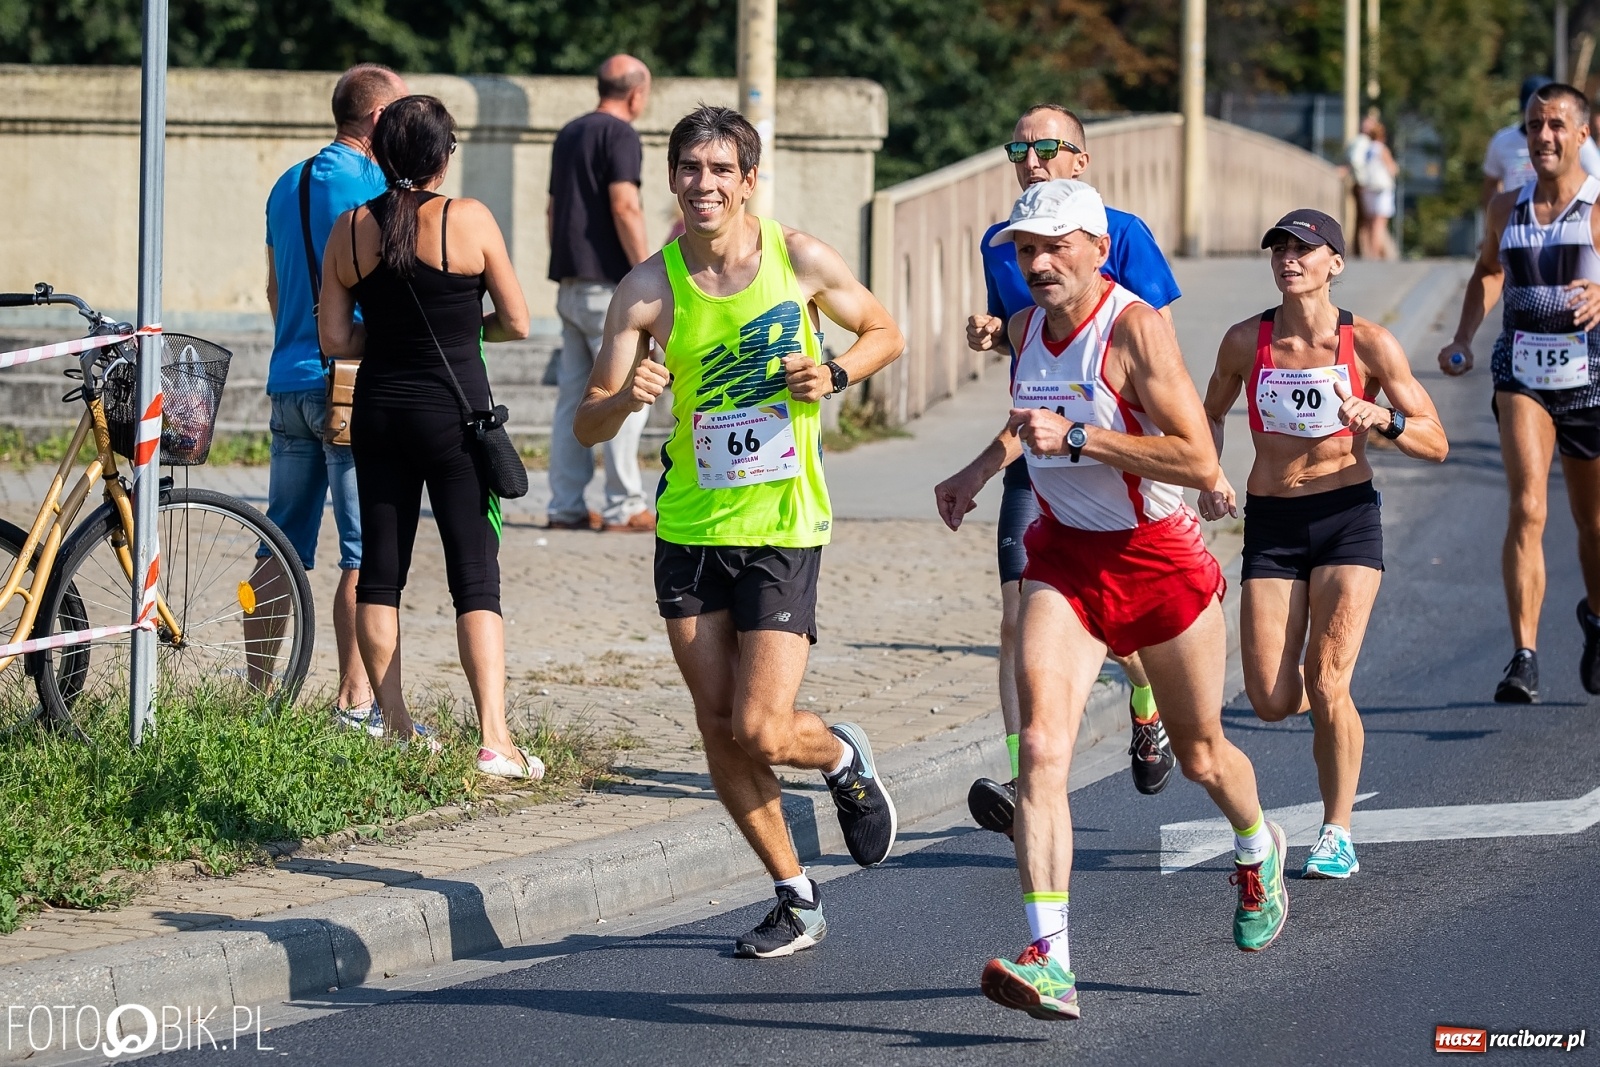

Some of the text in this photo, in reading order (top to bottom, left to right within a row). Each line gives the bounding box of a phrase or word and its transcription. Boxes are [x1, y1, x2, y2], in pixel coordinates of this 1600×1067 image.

[1536, 349, 1569, 367] 155
[1291, 388, 1322, 410] 90
[717, 412, 747, 422] RAFAKO
[727, 428, 761, 456] 66
